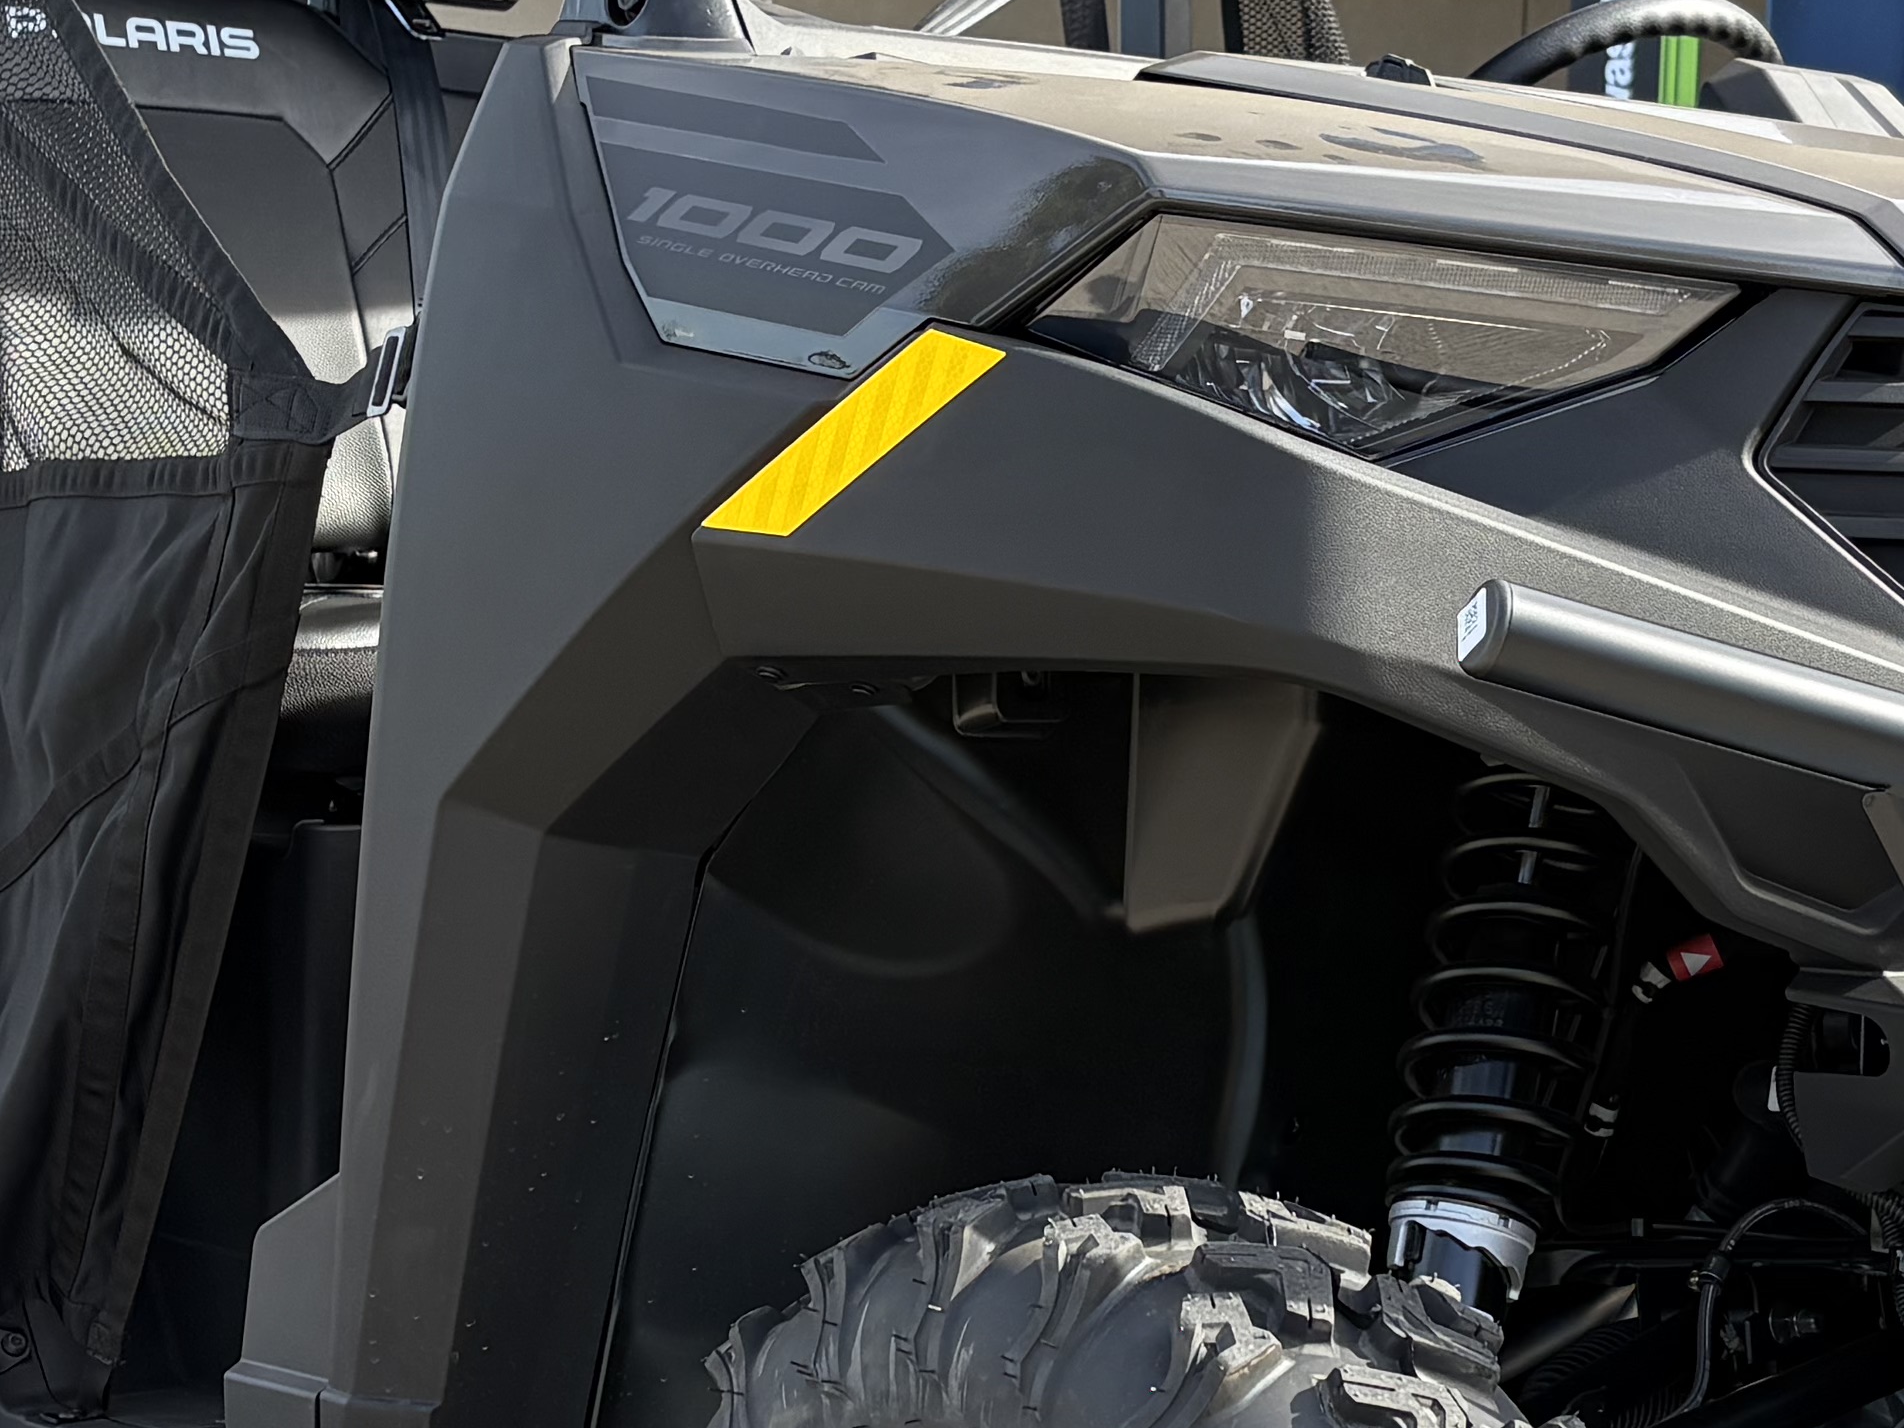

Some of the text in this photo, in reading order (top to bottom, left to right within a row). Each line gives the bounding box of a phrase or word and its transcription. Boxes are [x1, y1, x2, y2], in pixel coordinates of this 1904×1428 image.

[4, 5, 260, 60] PLARIS
[627, 186, 923, 274] 1000
[635, 234, 886, 295] SINGLE OVERHEAD CAM
